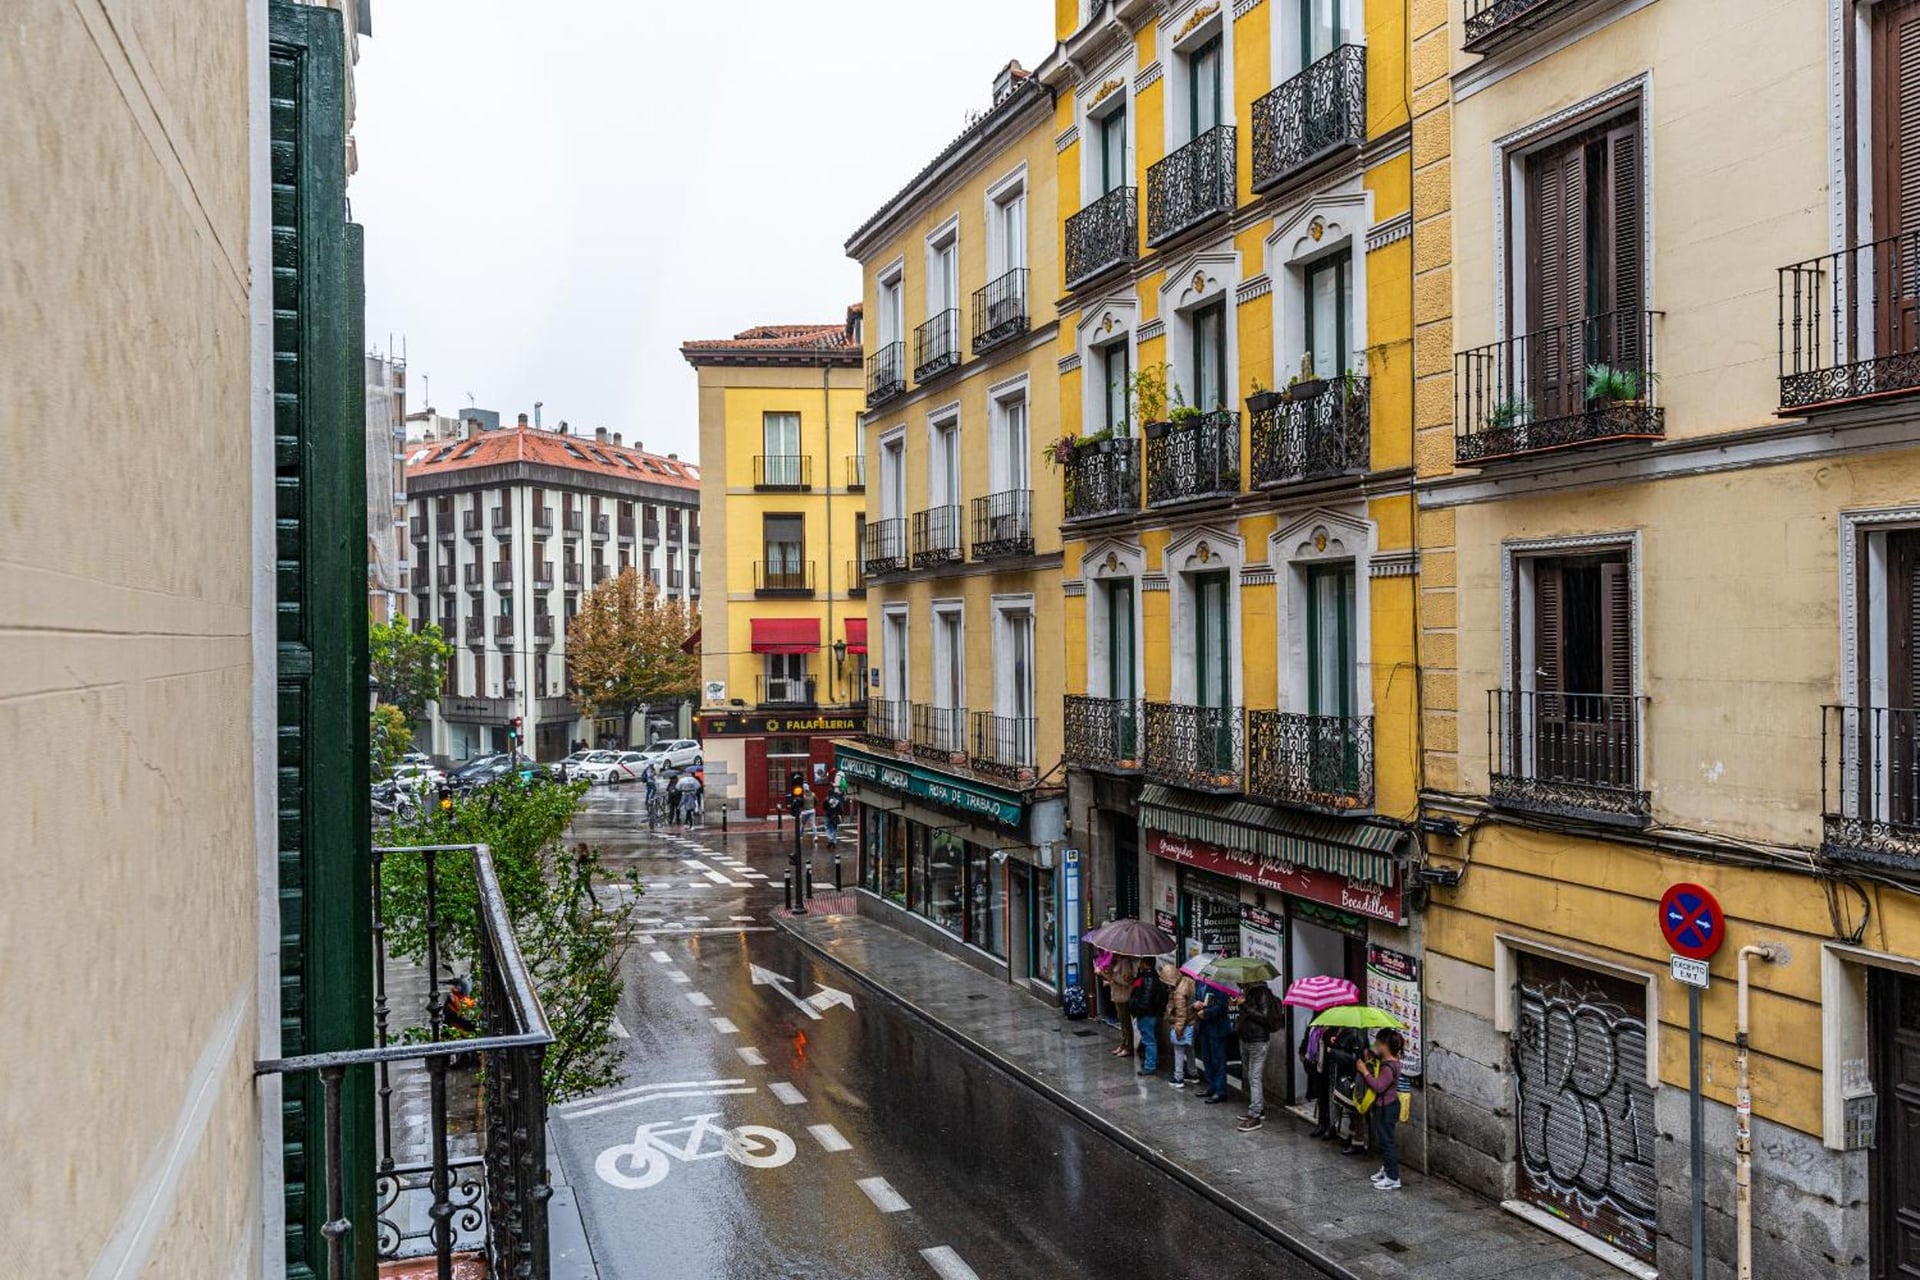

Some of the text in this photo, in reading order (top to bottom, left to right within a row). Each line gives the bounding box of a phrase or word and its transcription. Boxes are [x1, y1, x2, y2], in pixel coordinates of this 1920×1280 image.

[928, 784, 948, 799] ROPA
[951, 789, 961, 803] DE
[966, 793, 1001, 815] TRABAJO
[1673, 960, 1705, 975] EXCEPTO
